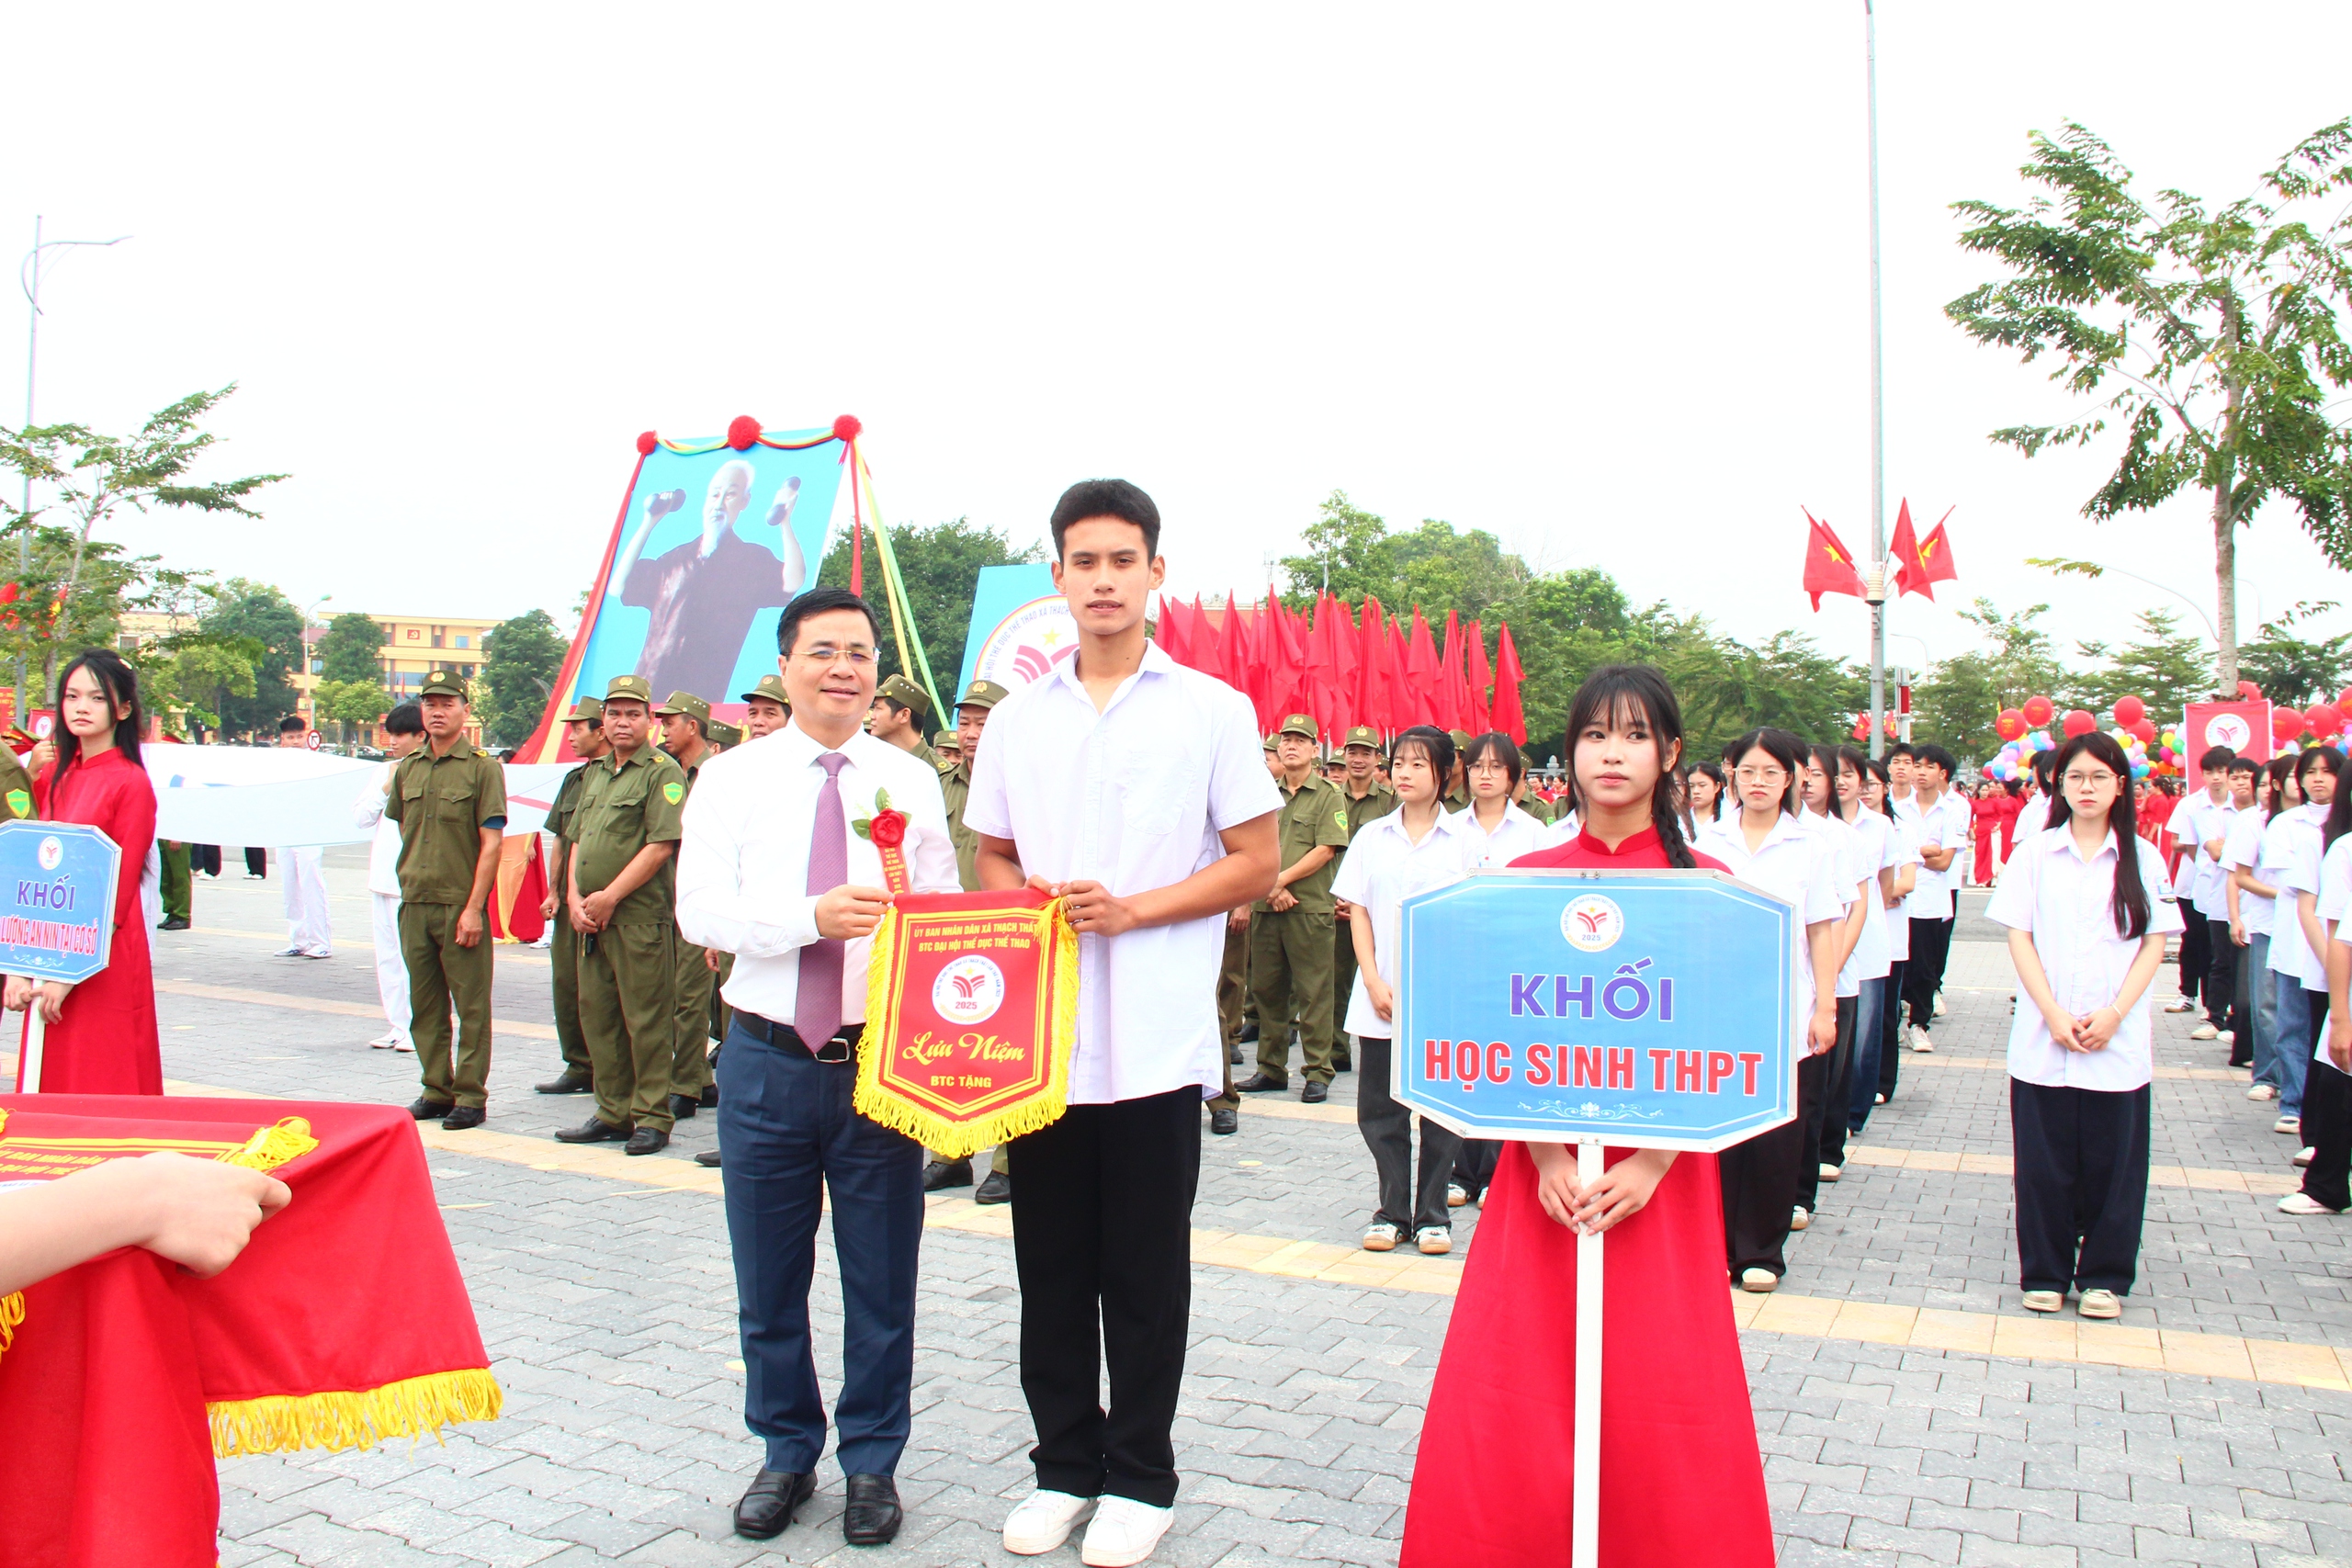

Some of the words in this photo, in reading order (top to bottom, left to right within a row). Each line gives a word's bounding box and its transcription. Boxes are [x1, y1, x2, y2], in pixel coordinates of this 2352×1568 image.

[1021, 610, 1037, 626] THAO
[17, 873, 76, 911] KHỐI
[0, 914, 30, 952] LƯỢNG
[29, 919, 42, 948] AN
[59, 923, 74, 958] TẠI
[74, 923, 86, 954] CƠ
[85, 918, 98, 956] SỞ
[914, 926, 924, 938] ỦY
[925, 928, 941, 937] BAN
[942, 924, 963, 936] NHÂN
[964, 923, 980, 935] DÂN
[981, 922, 991, 933] XÃ
[993, 921, 1017, 934] THẠCH
[919, 942, 933, 952] BTC
[933, 942, 947, 953] ĐẠI
[948, 939, 961, 952] HỘI
[963, 936, 978, 950] THỂ
[978, 938, 992, 950] DỤC
[994, 934, 1009, 948] THỂ
[1010, 938, 1030, 949] THAO
[1510, 956, 1674, 1022] KHỐI
[955, 1001, 978, 1010] 2025
[902, 1031, 954, 1066] Lưu
[957, 1032, 1025, 1065] Niệm
[931, 1075, 955, 1087] BTC
[958, 1074, 991, 1089] TẶNG
[1424, 1039, 1512, 1092] HỌC
[1525, 1043, 1635, 1091] SINH
[1647, 1047, 1763, 1097] THPT
